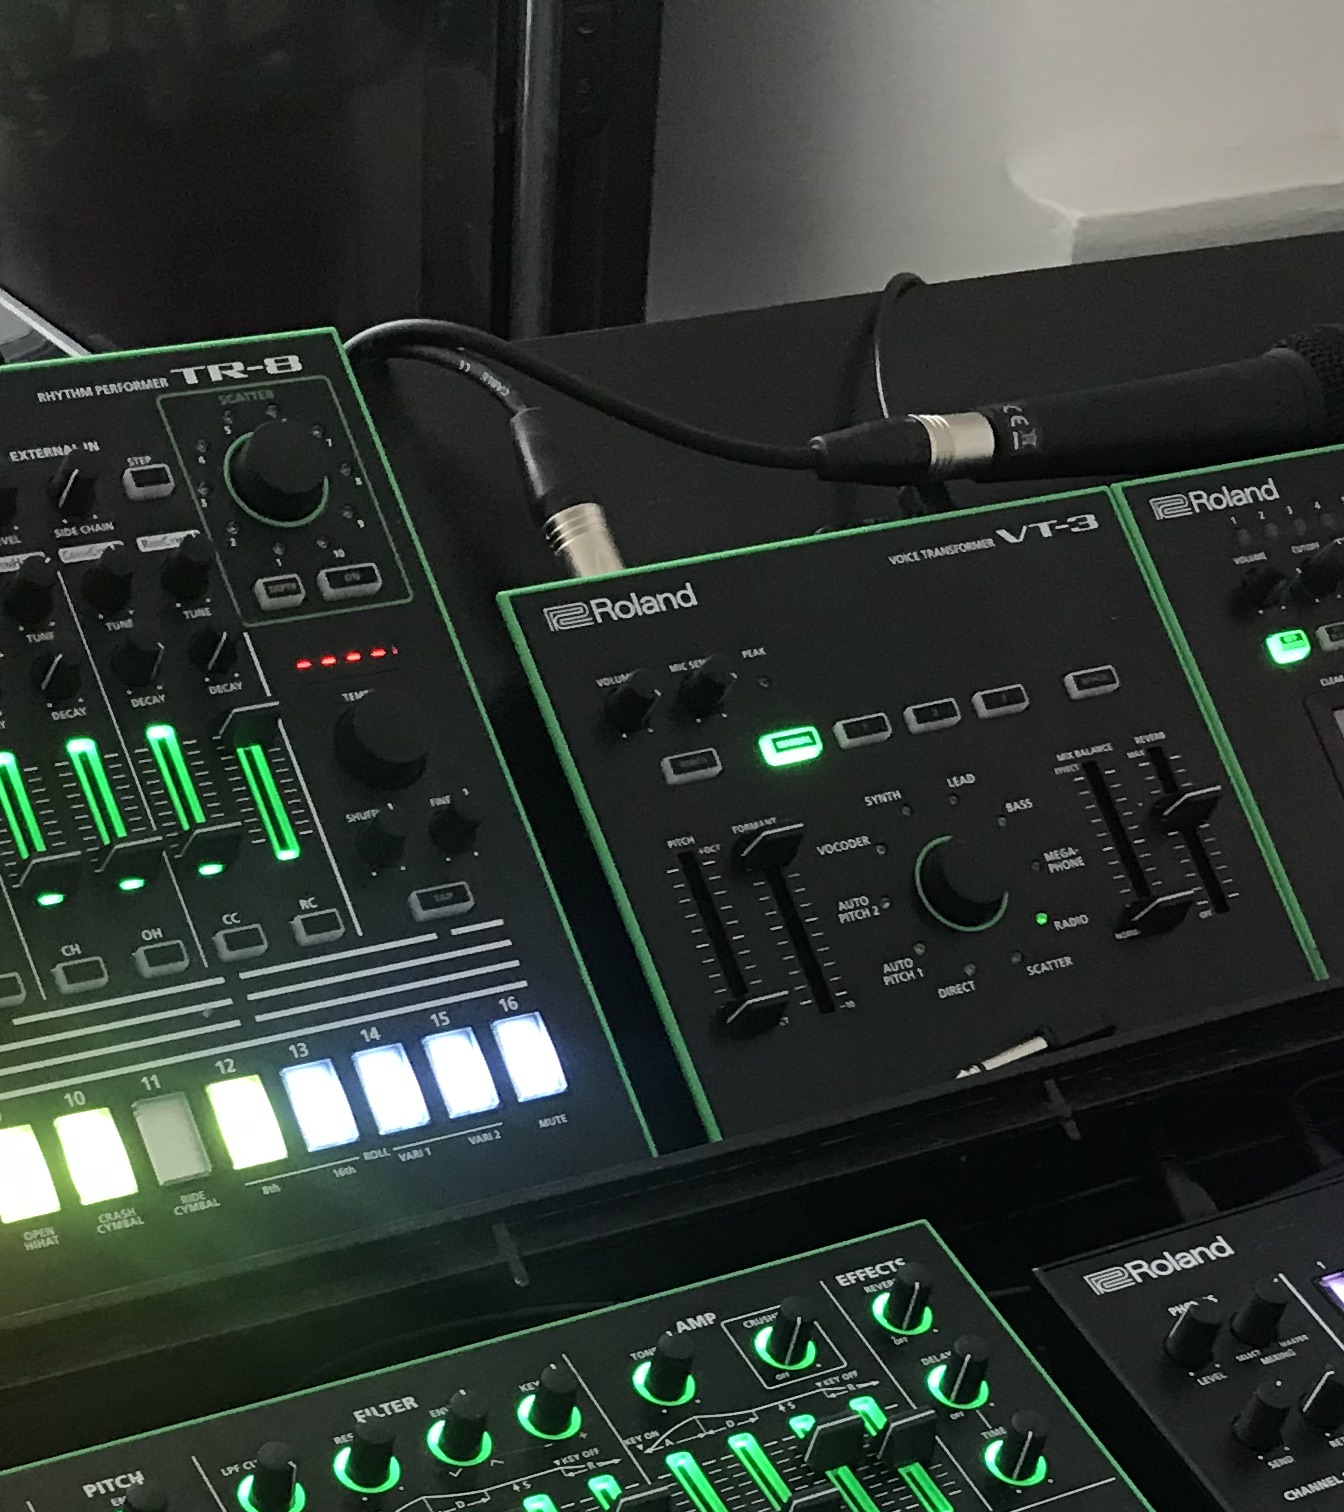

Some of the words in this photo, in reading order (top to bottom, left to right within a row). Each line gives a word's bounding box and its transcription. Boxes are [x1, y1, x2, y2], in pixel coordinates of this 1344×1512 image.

[36, 386, 91, 403] RHYTHM
[94, 377, 170, 396] PERFORMER
[169, 354, 304, 385] TR-8
[217, 389, 276, 405] SCATTER
[1189, 477, 1281, 513] Roland
[53, 526, 78, 539] SIDE
[79, 521, 115, 536] CHAIN
[888, 549, 920, 566] VOICE
[920, 537, 996, 560] TRANSFORMER
[996, 513, 1100, 544] VT-3
[590, 582, 699, 625] Roland
[1073, 742, 1114, 759] BALANCE
[946, 772, 976, 788] LEAD
[864, 790, 902, 807] SYNTH
[1005, 798, 1033, 814] BASS
[816, 834, 872, 857] VOCODER
[1043, 846, 1081, 864] MEGA-
[1047, 855, 1085, 874] PHONE
[298, 897, 318, 910] RC
[837, 895, 870, 912] AUTO
[222, 912, 241, 925] CC
[837, 906, 870, 925] PITCH
[871, 905, 881, 917] 2
[1053, 912, 1089, 931] RADIO
[141, 927, 163, 941] OH
[61, 943, 82, 957] CH
[882, 957, 914, 974] AUTO
[1026, 954, 1074, 977] SCATTER
[882, 970, 916, 988] PITCH
[937, 980, 976, 1000] DIRECT
[497, 996, 519, 1012] 16
[430, 1011, 451, 1027] 15
[360, 1027, 381, 1042] 14
[288, 1042, 309, 1059] 13
[214, 1058, 237, 1075] 12
[140, 1074, 161, 1091] 11
[63, 1090, 86, 1107] 10
[537, 1113, 569, 1130] MUTE
[23, 1226, 56, 1242] OPEN
[24, 1234, 60, 1250] HIHAT
[1124, 1235, 1235, 1283] Roland
[835, 1258, 906, 1287] EFFECTS
[675, 1311, 718, 1337] AMP
[352, 1396, 419, 1424] FILTER
[1267, 1454, 1296, 1471] SEND
[82, 1470, 145, 1499] PITCH
[1283, 1470, 1342, 1503] CHANNEL
